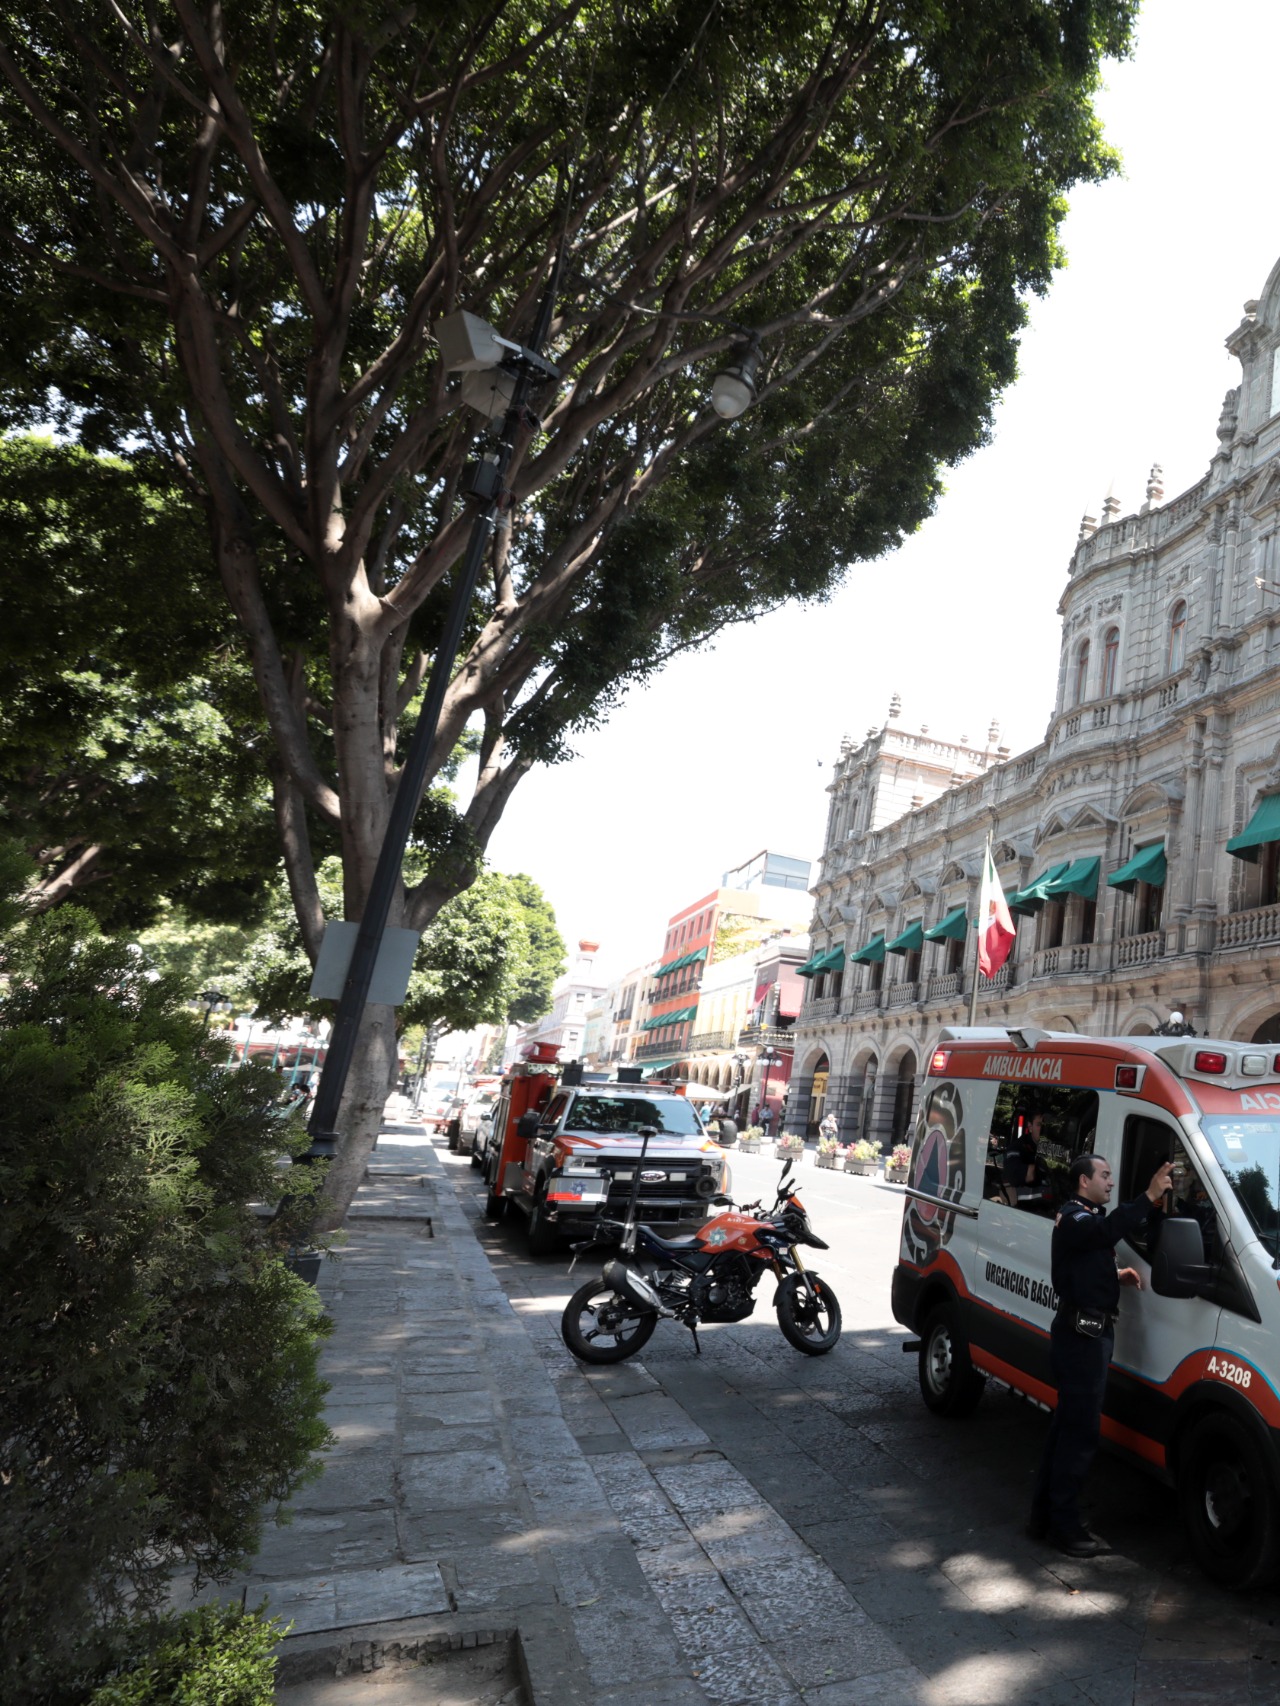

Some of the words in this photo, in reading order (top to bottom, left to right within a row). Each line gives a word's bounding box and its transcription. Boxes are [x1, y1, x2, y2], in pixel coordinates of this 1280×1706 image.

[982, 1056, 1063, 1081] AMBULANCIA
[986, 1260, 1030, 1299] URGENCIAS
[1031, 1279, 1060, 1312] BÁSIC
[1207, 1355, 1252, 1388] A-3208
